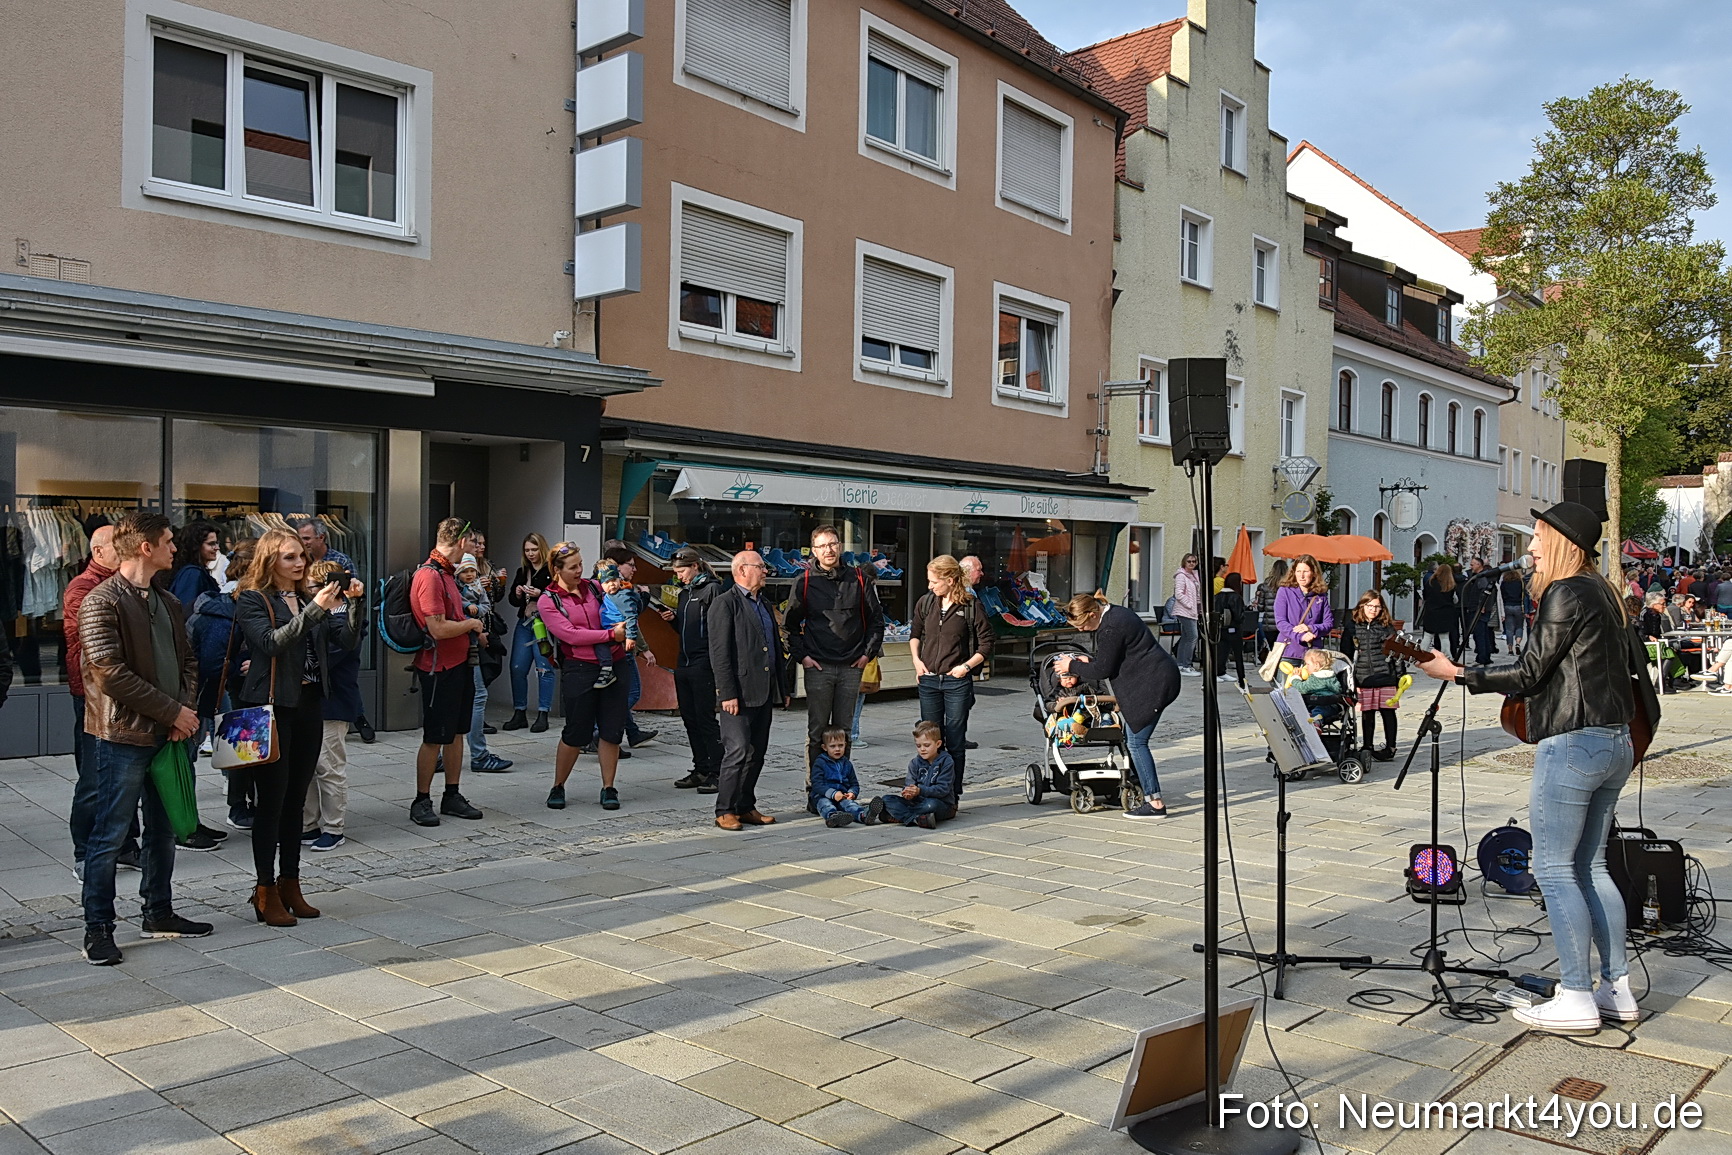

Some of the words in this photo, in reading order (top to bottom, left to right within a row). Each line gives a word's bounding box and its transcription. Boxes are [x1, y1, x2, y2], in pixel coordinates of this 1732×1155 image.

[580, 445, 591, 463] 7
[1021, 496, 1036, 514] Die
[1036, 497, 1059, 515] süße
